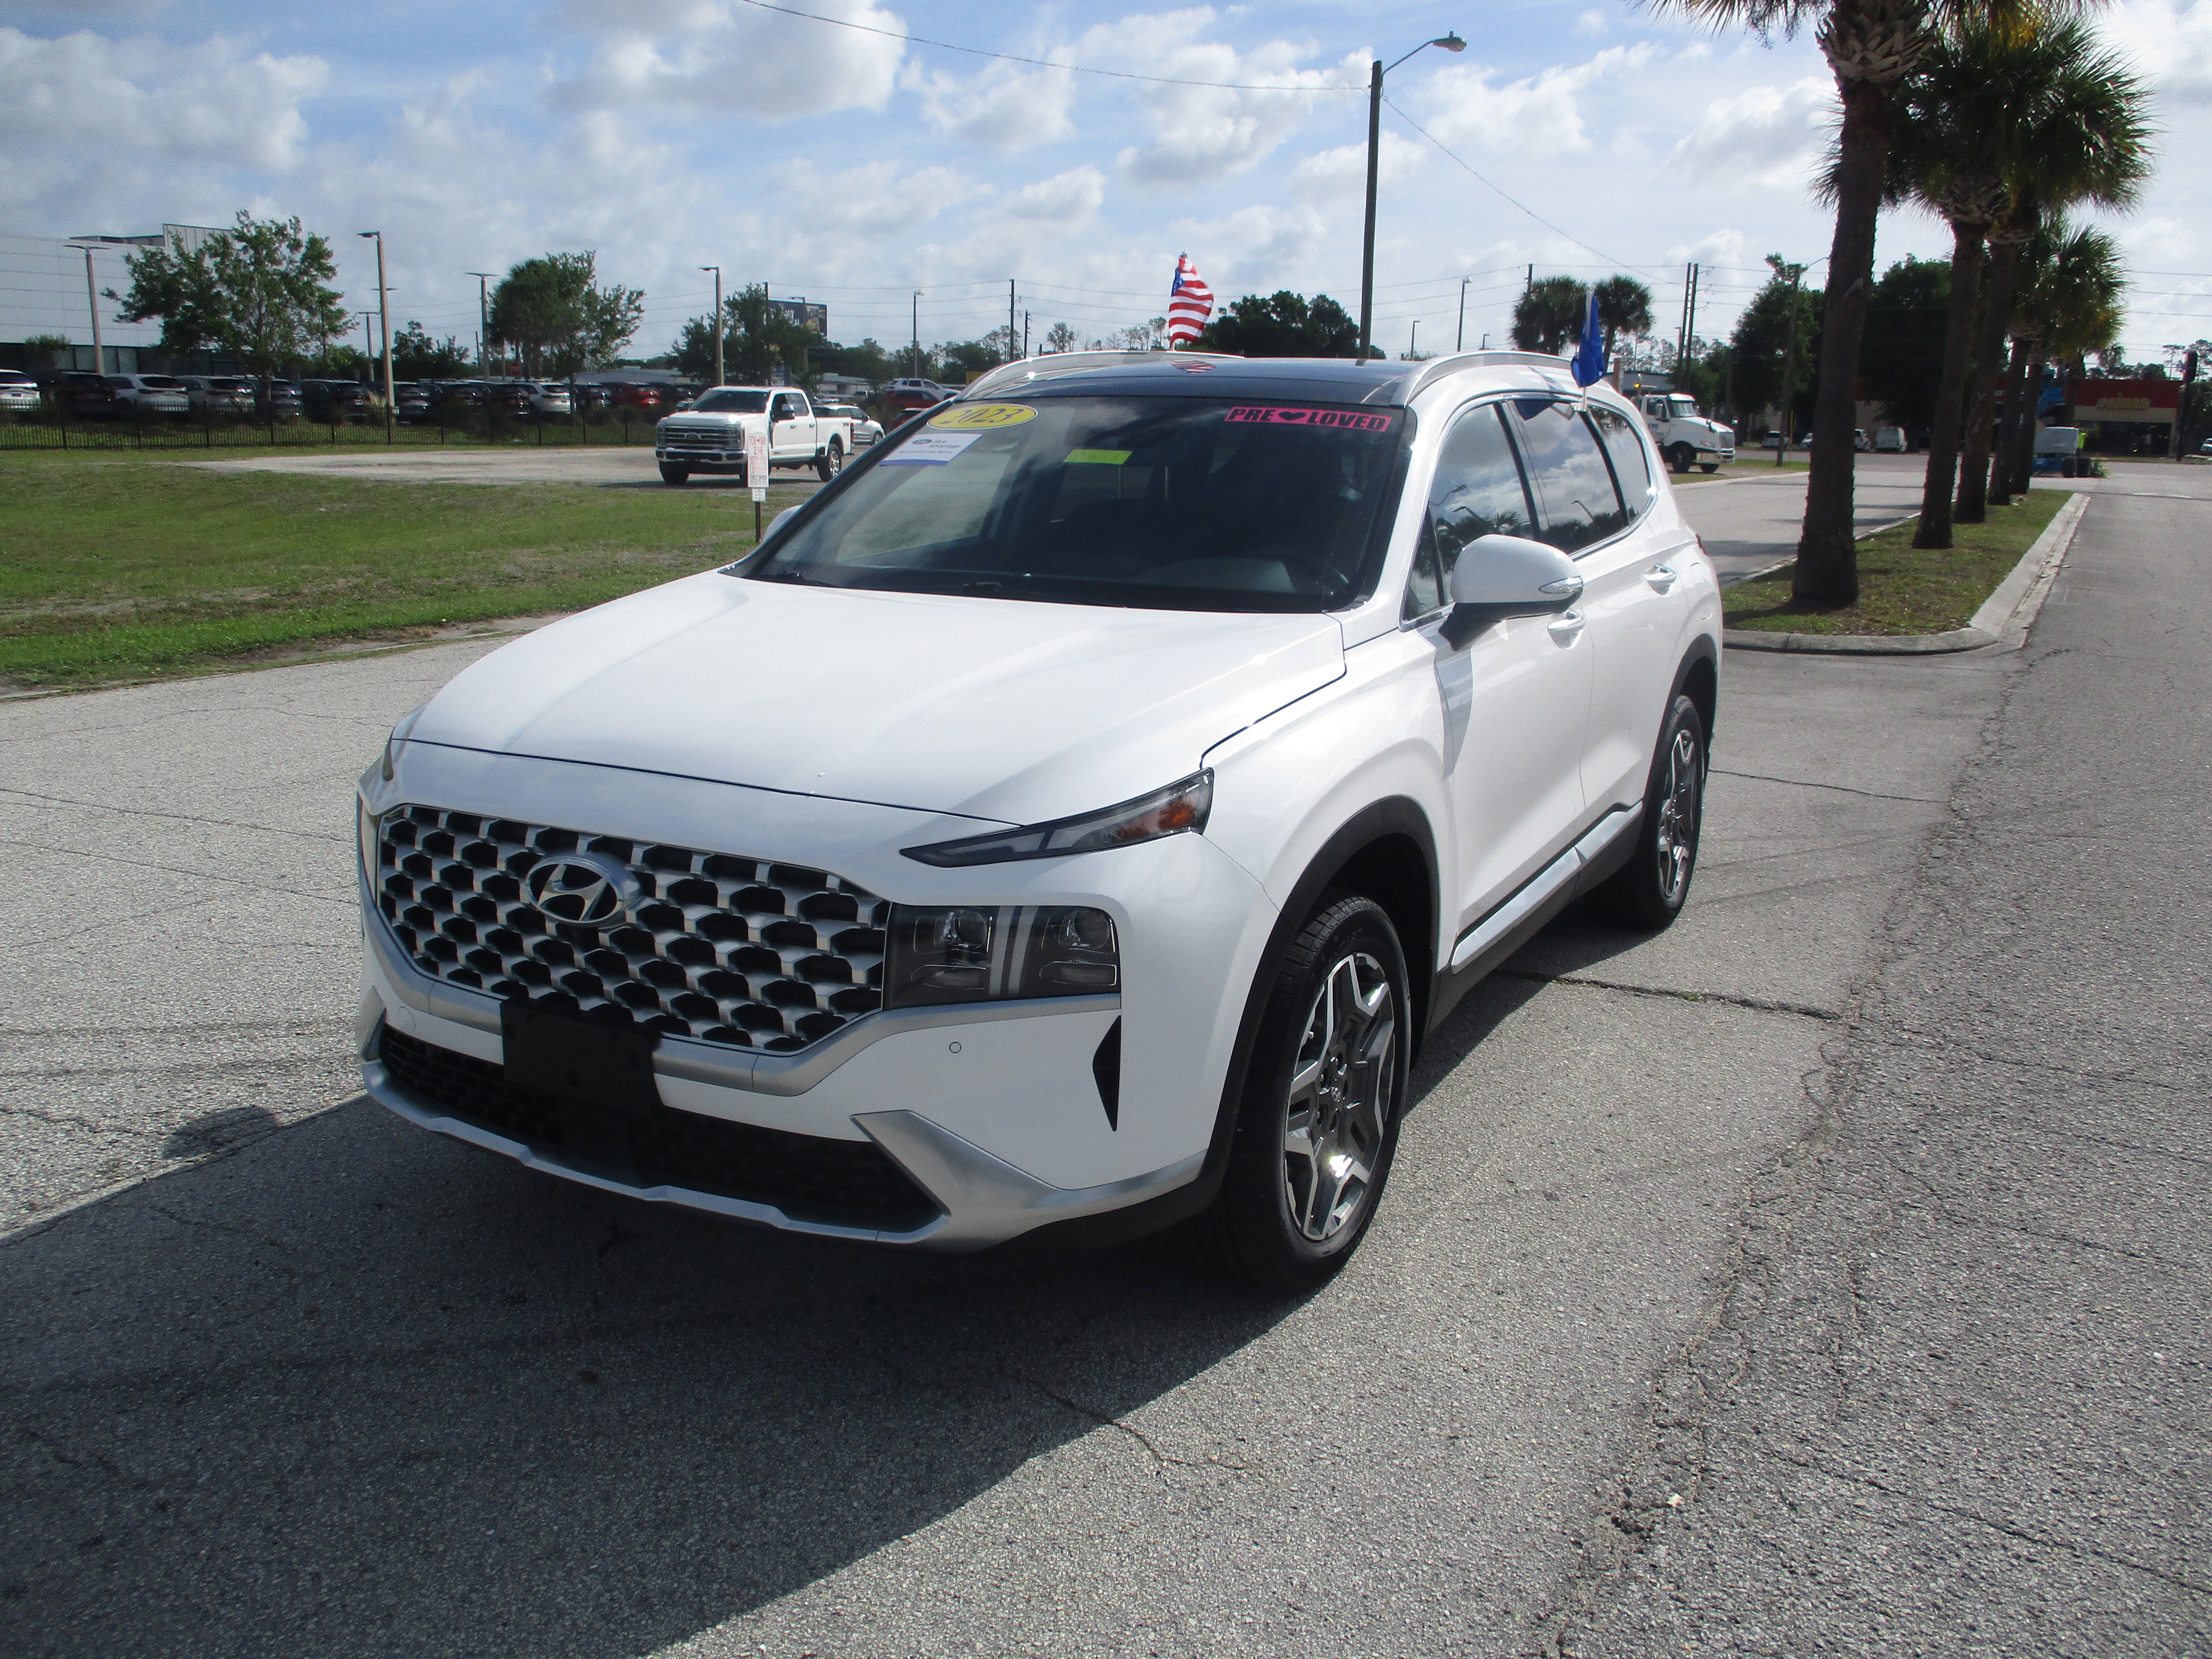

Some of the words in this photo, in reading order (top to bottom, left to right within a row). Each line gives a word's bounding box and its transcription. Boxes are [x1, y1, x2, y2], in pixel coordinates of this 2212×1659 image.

[939, 408, 1024, 425] 2023
[1227, 408, 1276, 421] PRE
[1307, 411, 1386, 430] LOVED
